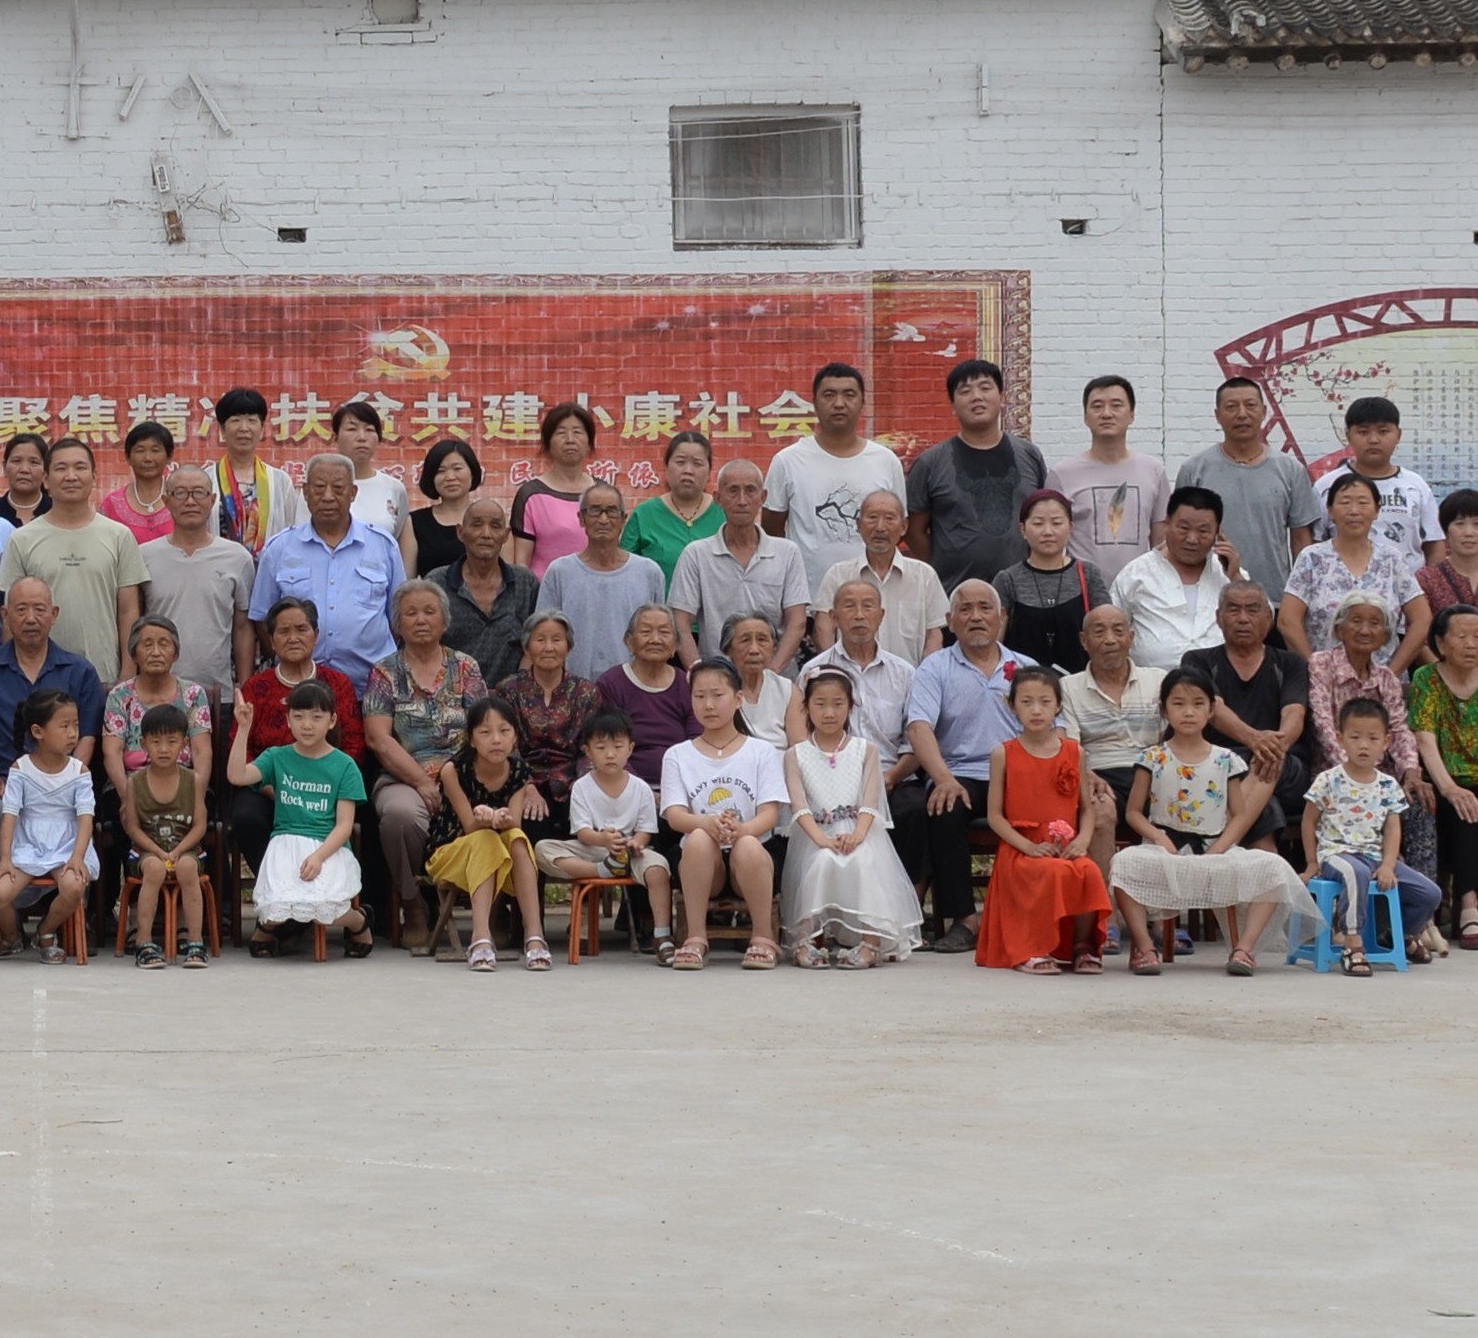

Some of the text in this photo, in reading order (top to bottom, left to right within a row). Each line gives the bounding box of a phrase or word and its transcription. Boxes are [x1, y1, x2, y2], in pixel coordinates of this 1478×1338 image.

[282, 773, 332, 794] Norman
[711, 776, 733, 785] WILD
[734, 778, 756, 802] STORM
